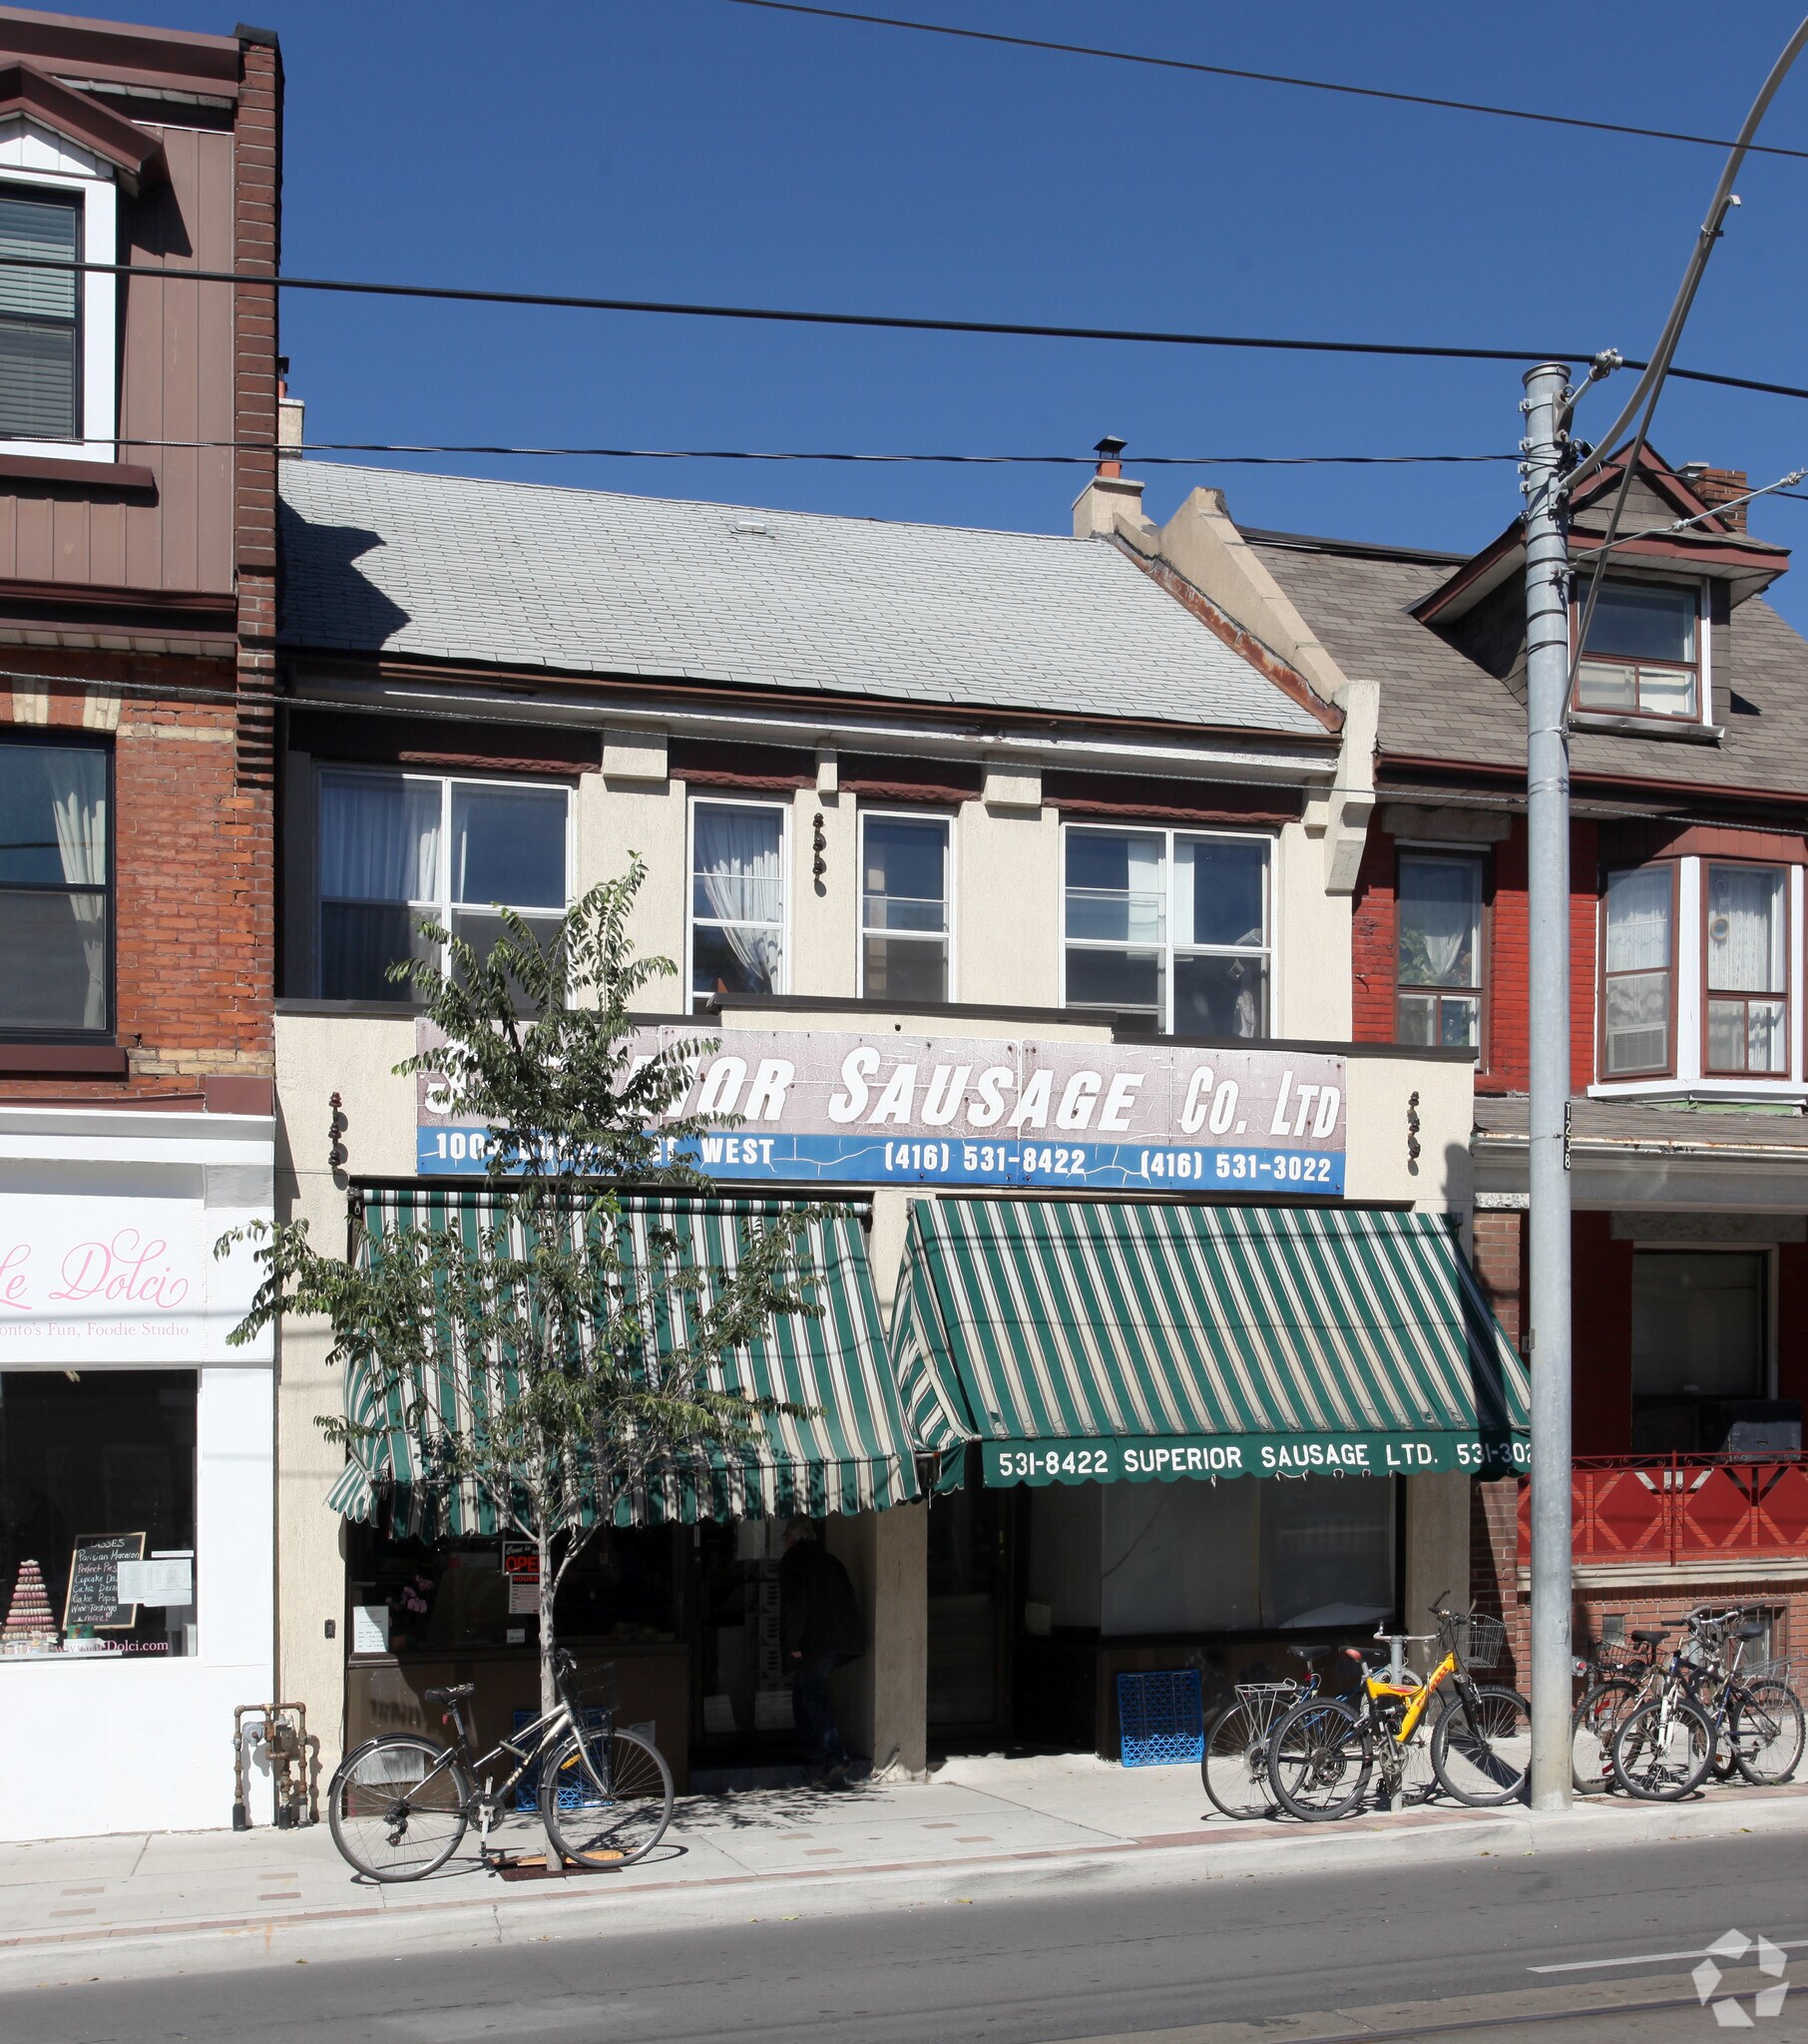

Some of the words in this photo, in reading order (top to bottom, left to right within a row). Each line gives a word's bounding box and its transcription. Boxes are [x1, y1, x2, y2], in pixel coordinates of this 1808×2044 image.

[827, 1046, 1145, 1132] SAUSAGE
[1179, 1066, 1247, 1136] CO.
[1270, 1070, 1341, 1140] LTD
[700, 1137, 775, 1164] WEST
[885, 1141, 950, 1173] (416)
[963, 1146, 1086, 1174] 531-8422
[1140, 1150, 1202, 1180] (416)
[1215, 1154, 1330, 1182] 531-3022
[49, 1229, 189, 1308] Dolci
[47, 1322, 81, 1337] Fun,
[87, 1322, 137, 1336] Foodie
[141, 1322, 190, 1336] Studio
[999, 1450, 1109, 1476] 531-8422
[1124, 1446, 1242, 1472] SUPERIOR
[1261, 1443, 1370, 1468] SAUSAGE
[1386, 1443, 1439, 1465] LTD.
[506, 1556, 540, 1572] OPE
